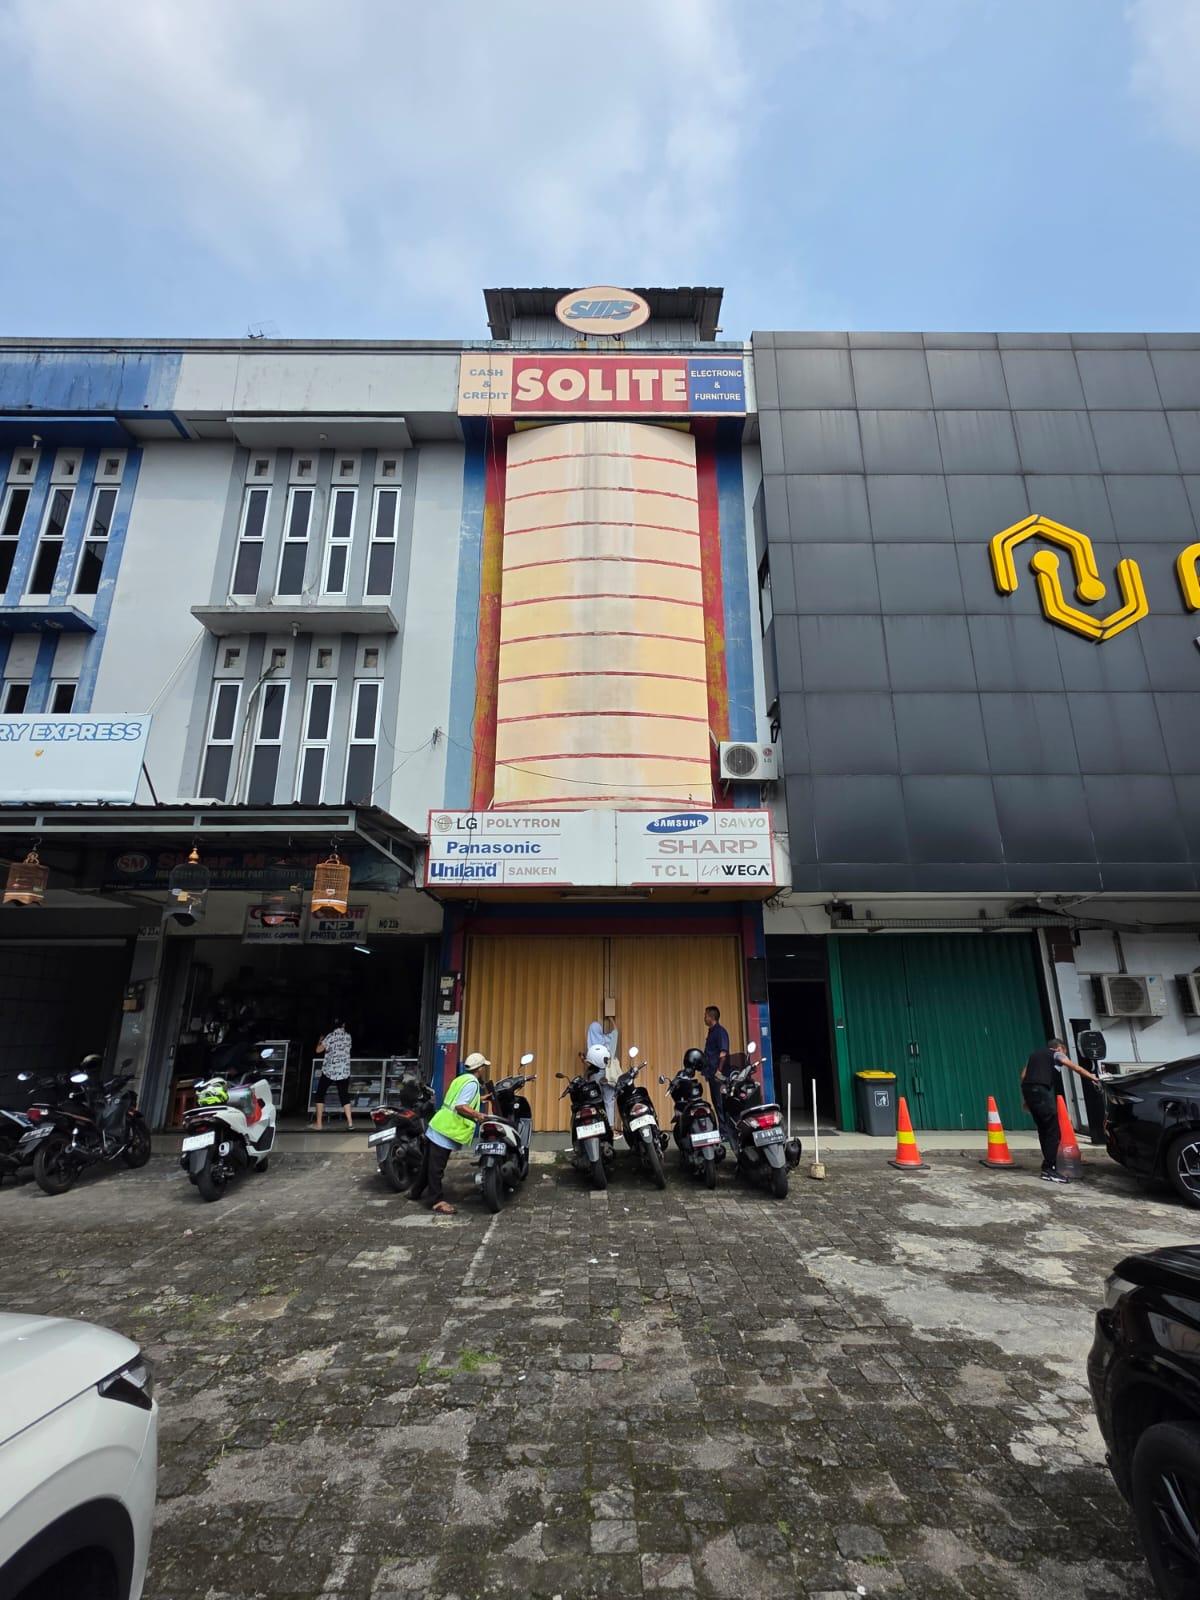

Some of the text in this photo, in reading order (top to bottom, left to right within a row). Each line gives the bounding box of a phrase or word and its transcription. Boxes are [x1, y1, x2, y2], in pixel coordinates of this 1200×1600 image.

[470, 369, 503, 377] CASH
[691, 369, 742, 377] ELECTRONIC
[515, 368, 687, 402] SOLITE
[29, 723, 142, 742] EXPRESS
[456, 818, 478, 830] LG
[486, 818, 561, 828] POLYTRON
[653, 819, 703, 827] SAMSUNG
[719, 817, 766, 828] SANYO
[446, 841, 542, 854] Panasonic
[658, 839, 758, 854] SHARP
[430, 862, 497, 878] Uniland
[508, 867, 557, 876] SANKEN
[651, 865, 689, 877] TCL
[325, 922, 349, 930] NP
[310, 931, 361, 940] PHOTO COPY
